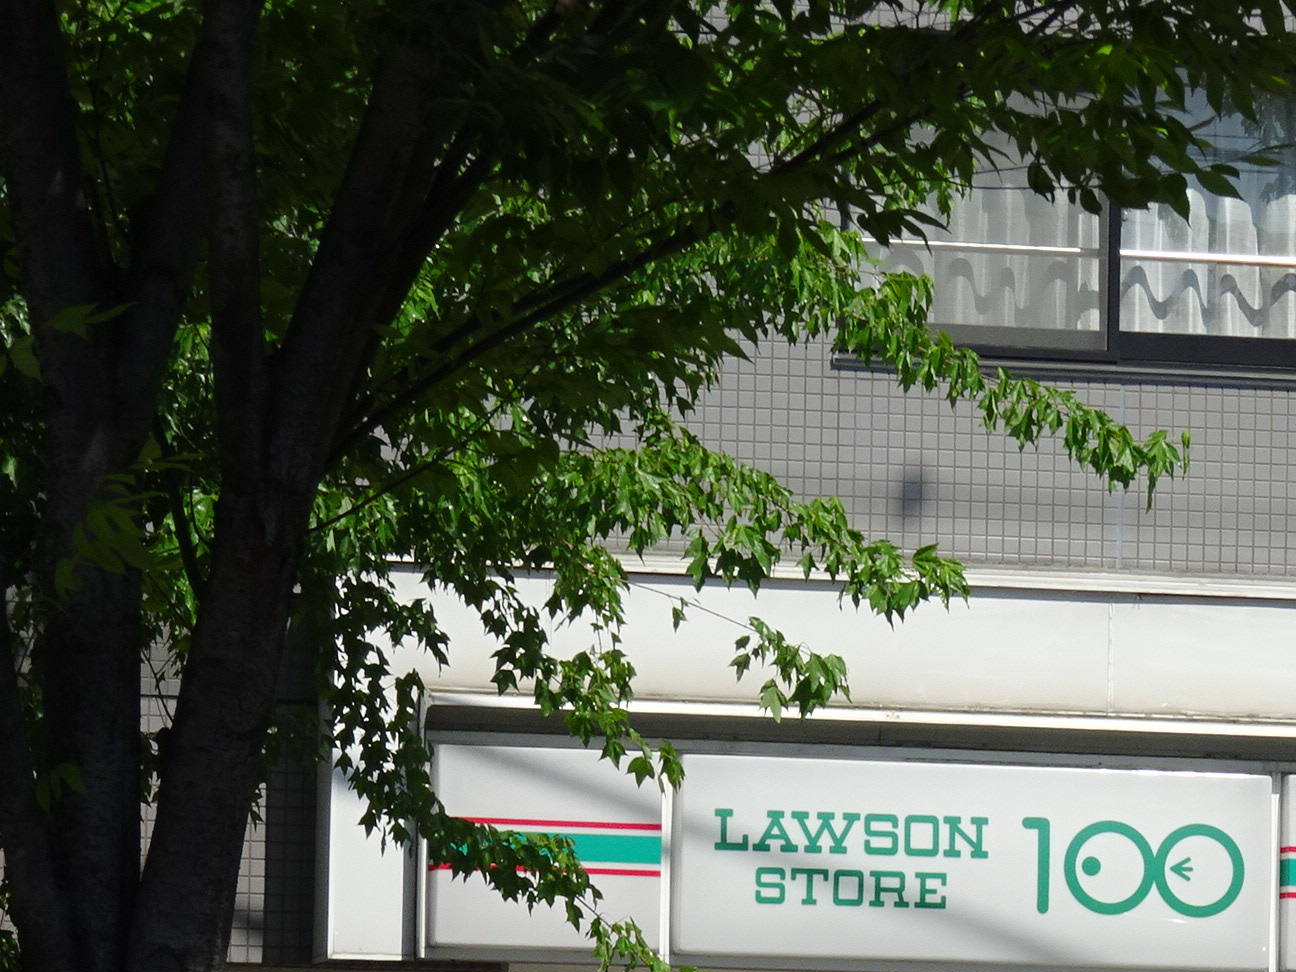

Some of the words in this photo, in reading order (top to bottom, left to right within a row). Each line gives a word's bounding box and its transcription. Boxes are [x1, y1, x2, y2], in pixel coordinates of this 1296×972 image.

[714, 808, 988, 860] LAWSON
[754, 867, 948, 909] STORE
[1022, 816, 1245, 917] 100
